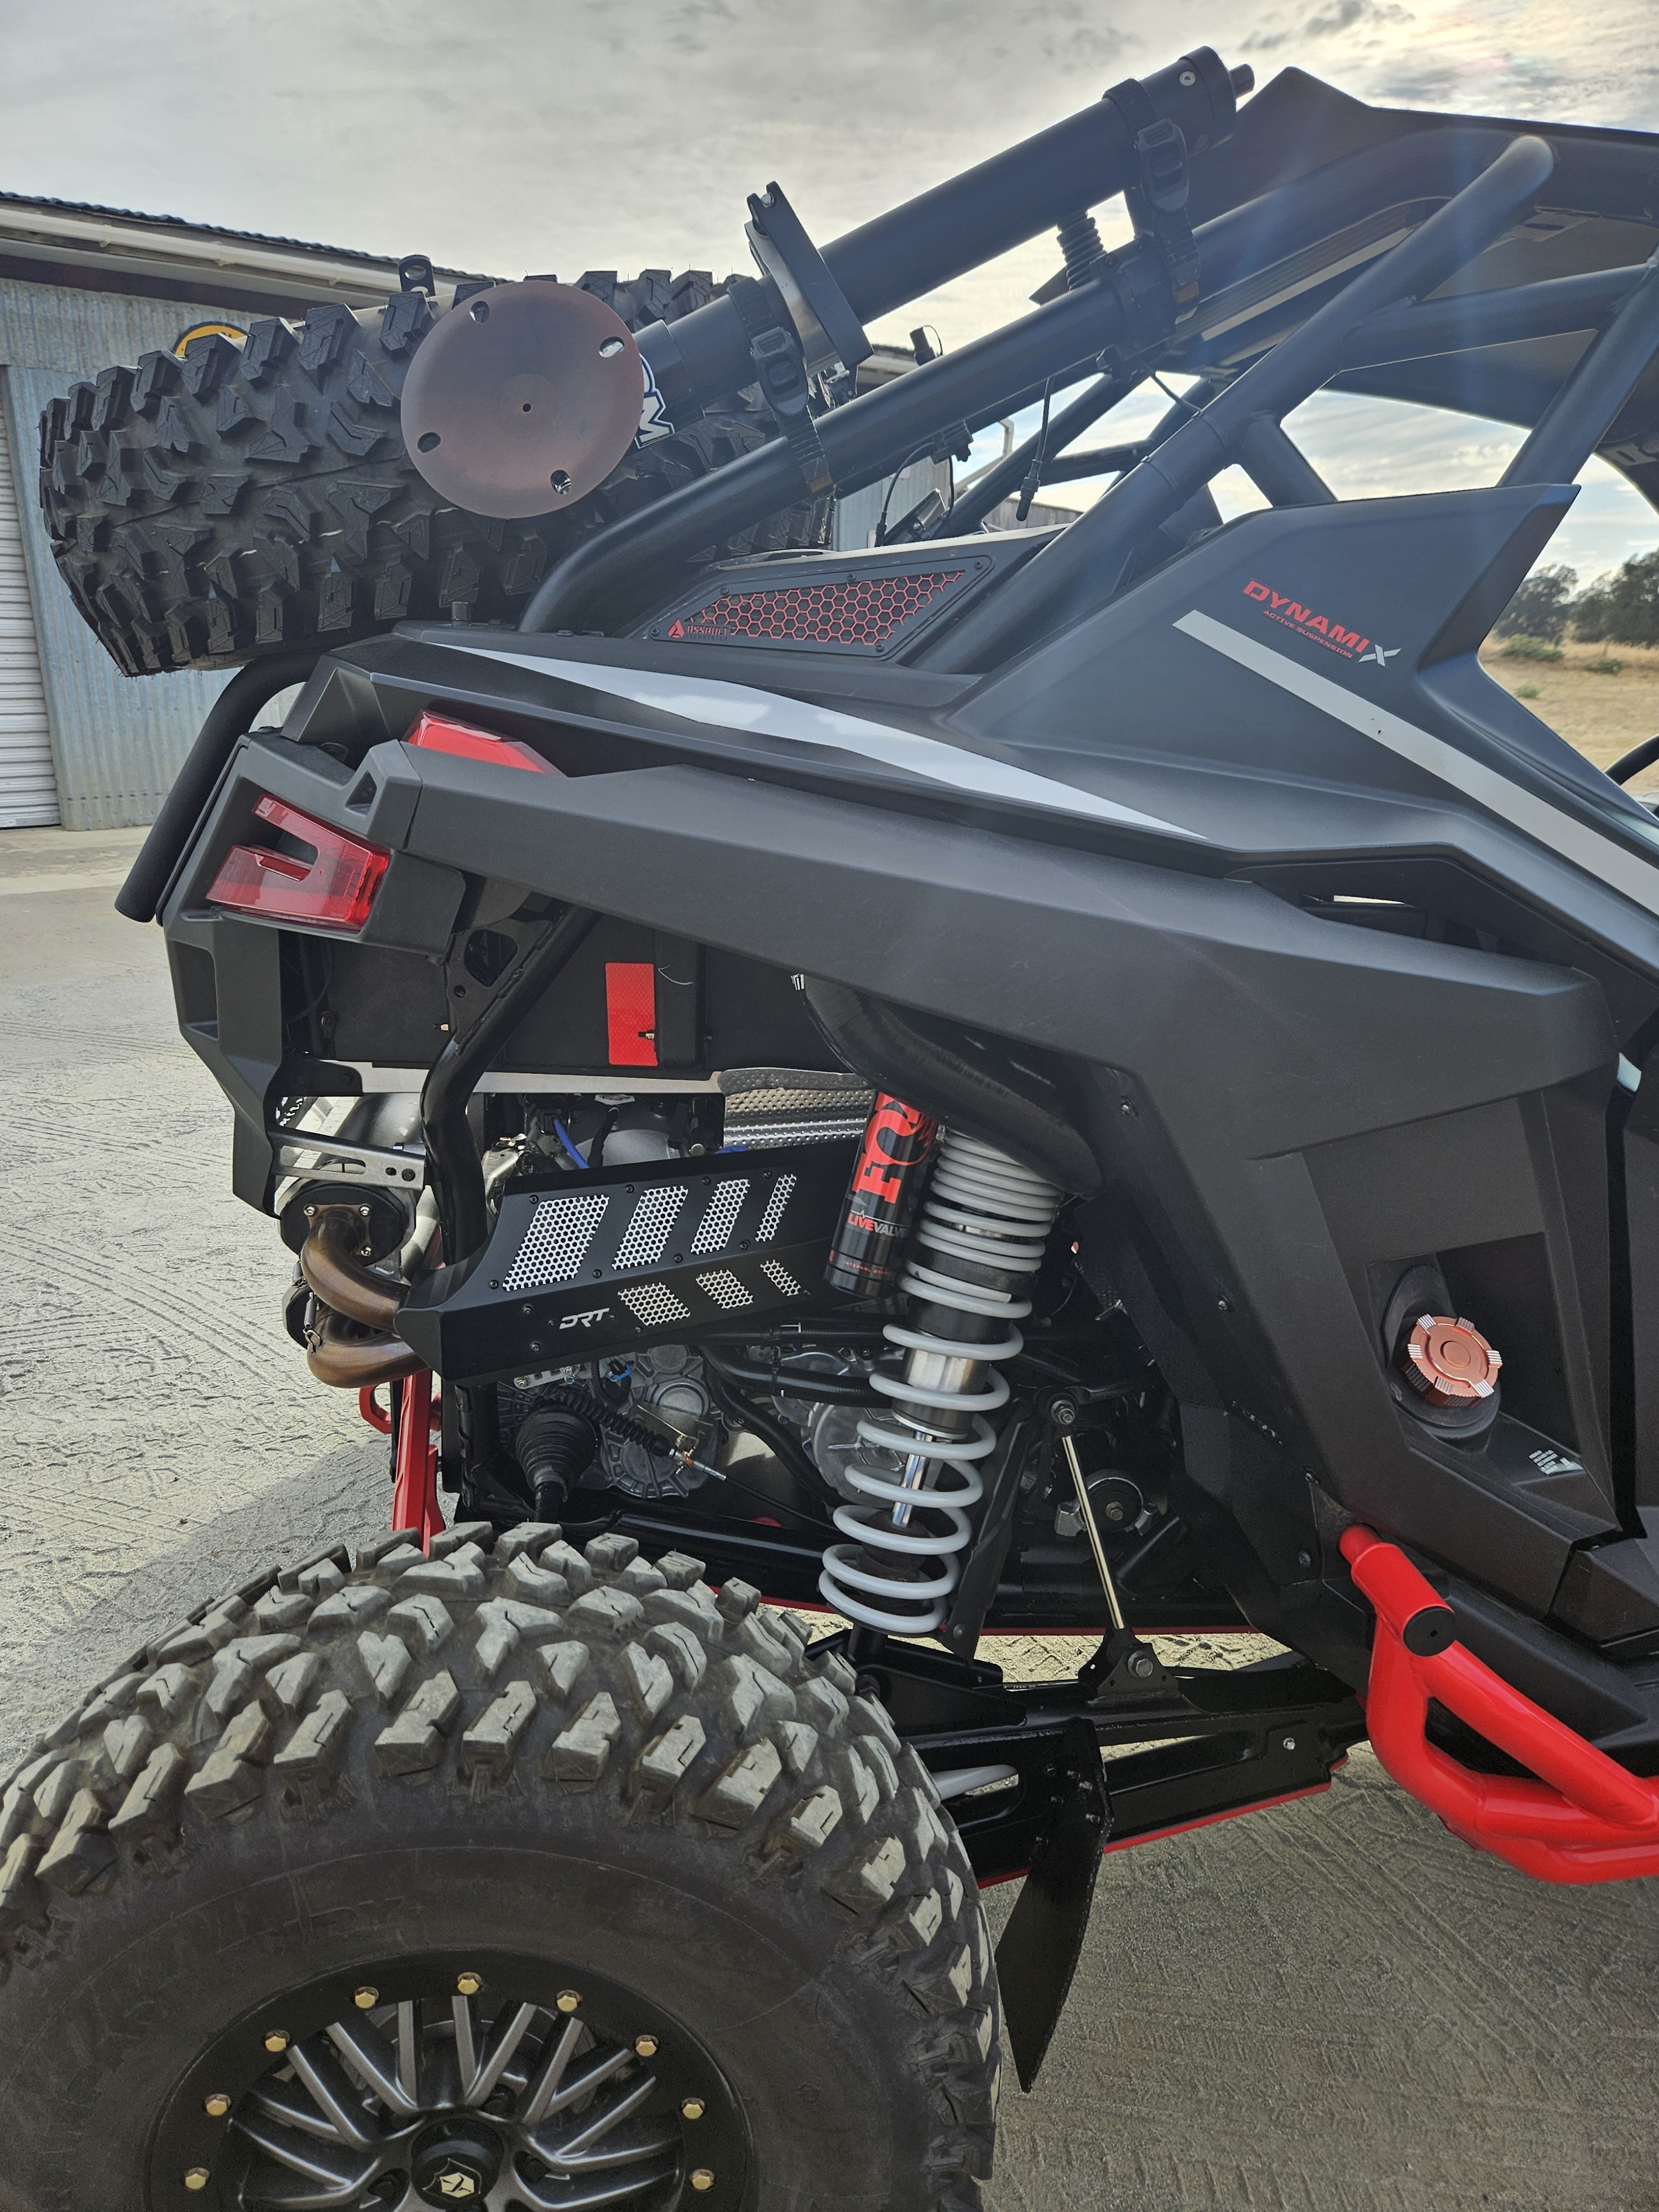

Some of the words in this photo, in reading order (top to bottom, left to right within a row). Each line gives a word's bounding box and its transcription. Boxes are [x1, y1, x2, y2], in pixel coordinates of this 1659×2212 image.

[687, 624, 728, 636] ASSAULT
[1263, 609, 1295, 628] ACTIVE
[1296, 626, 1353, 659] SUSPENSION
[559, 1307, 610, 1329] DRT
